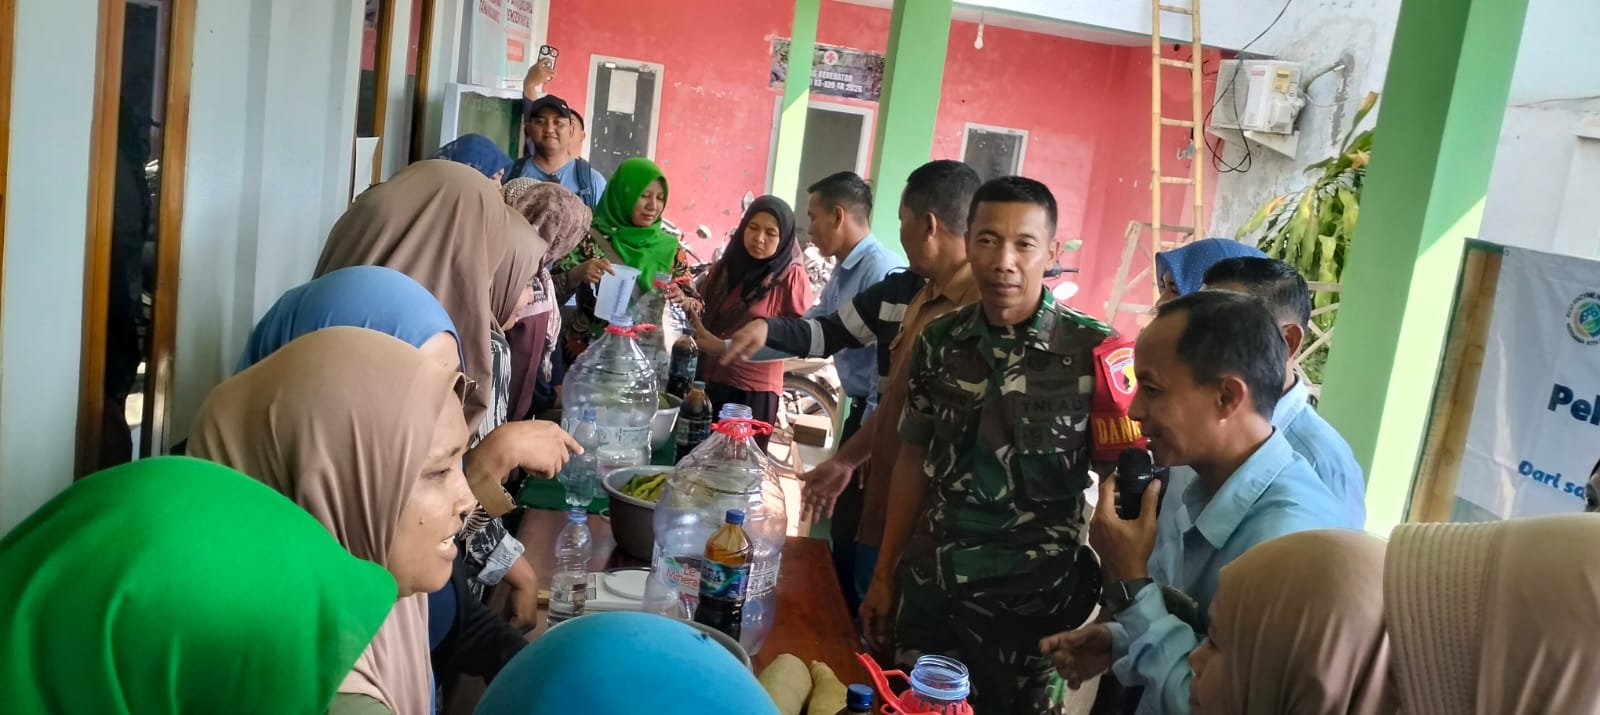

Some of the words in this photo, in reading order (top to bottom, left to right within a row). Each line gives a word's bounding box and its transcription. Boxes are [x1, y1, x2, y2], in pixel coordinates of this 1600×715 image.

[1023, 399, 1053, 412] TNI
[1060, 399, 1083, 411] AD
[1518, 460, 1562, 489] Dari
[684, 563, 698, 577] Le
